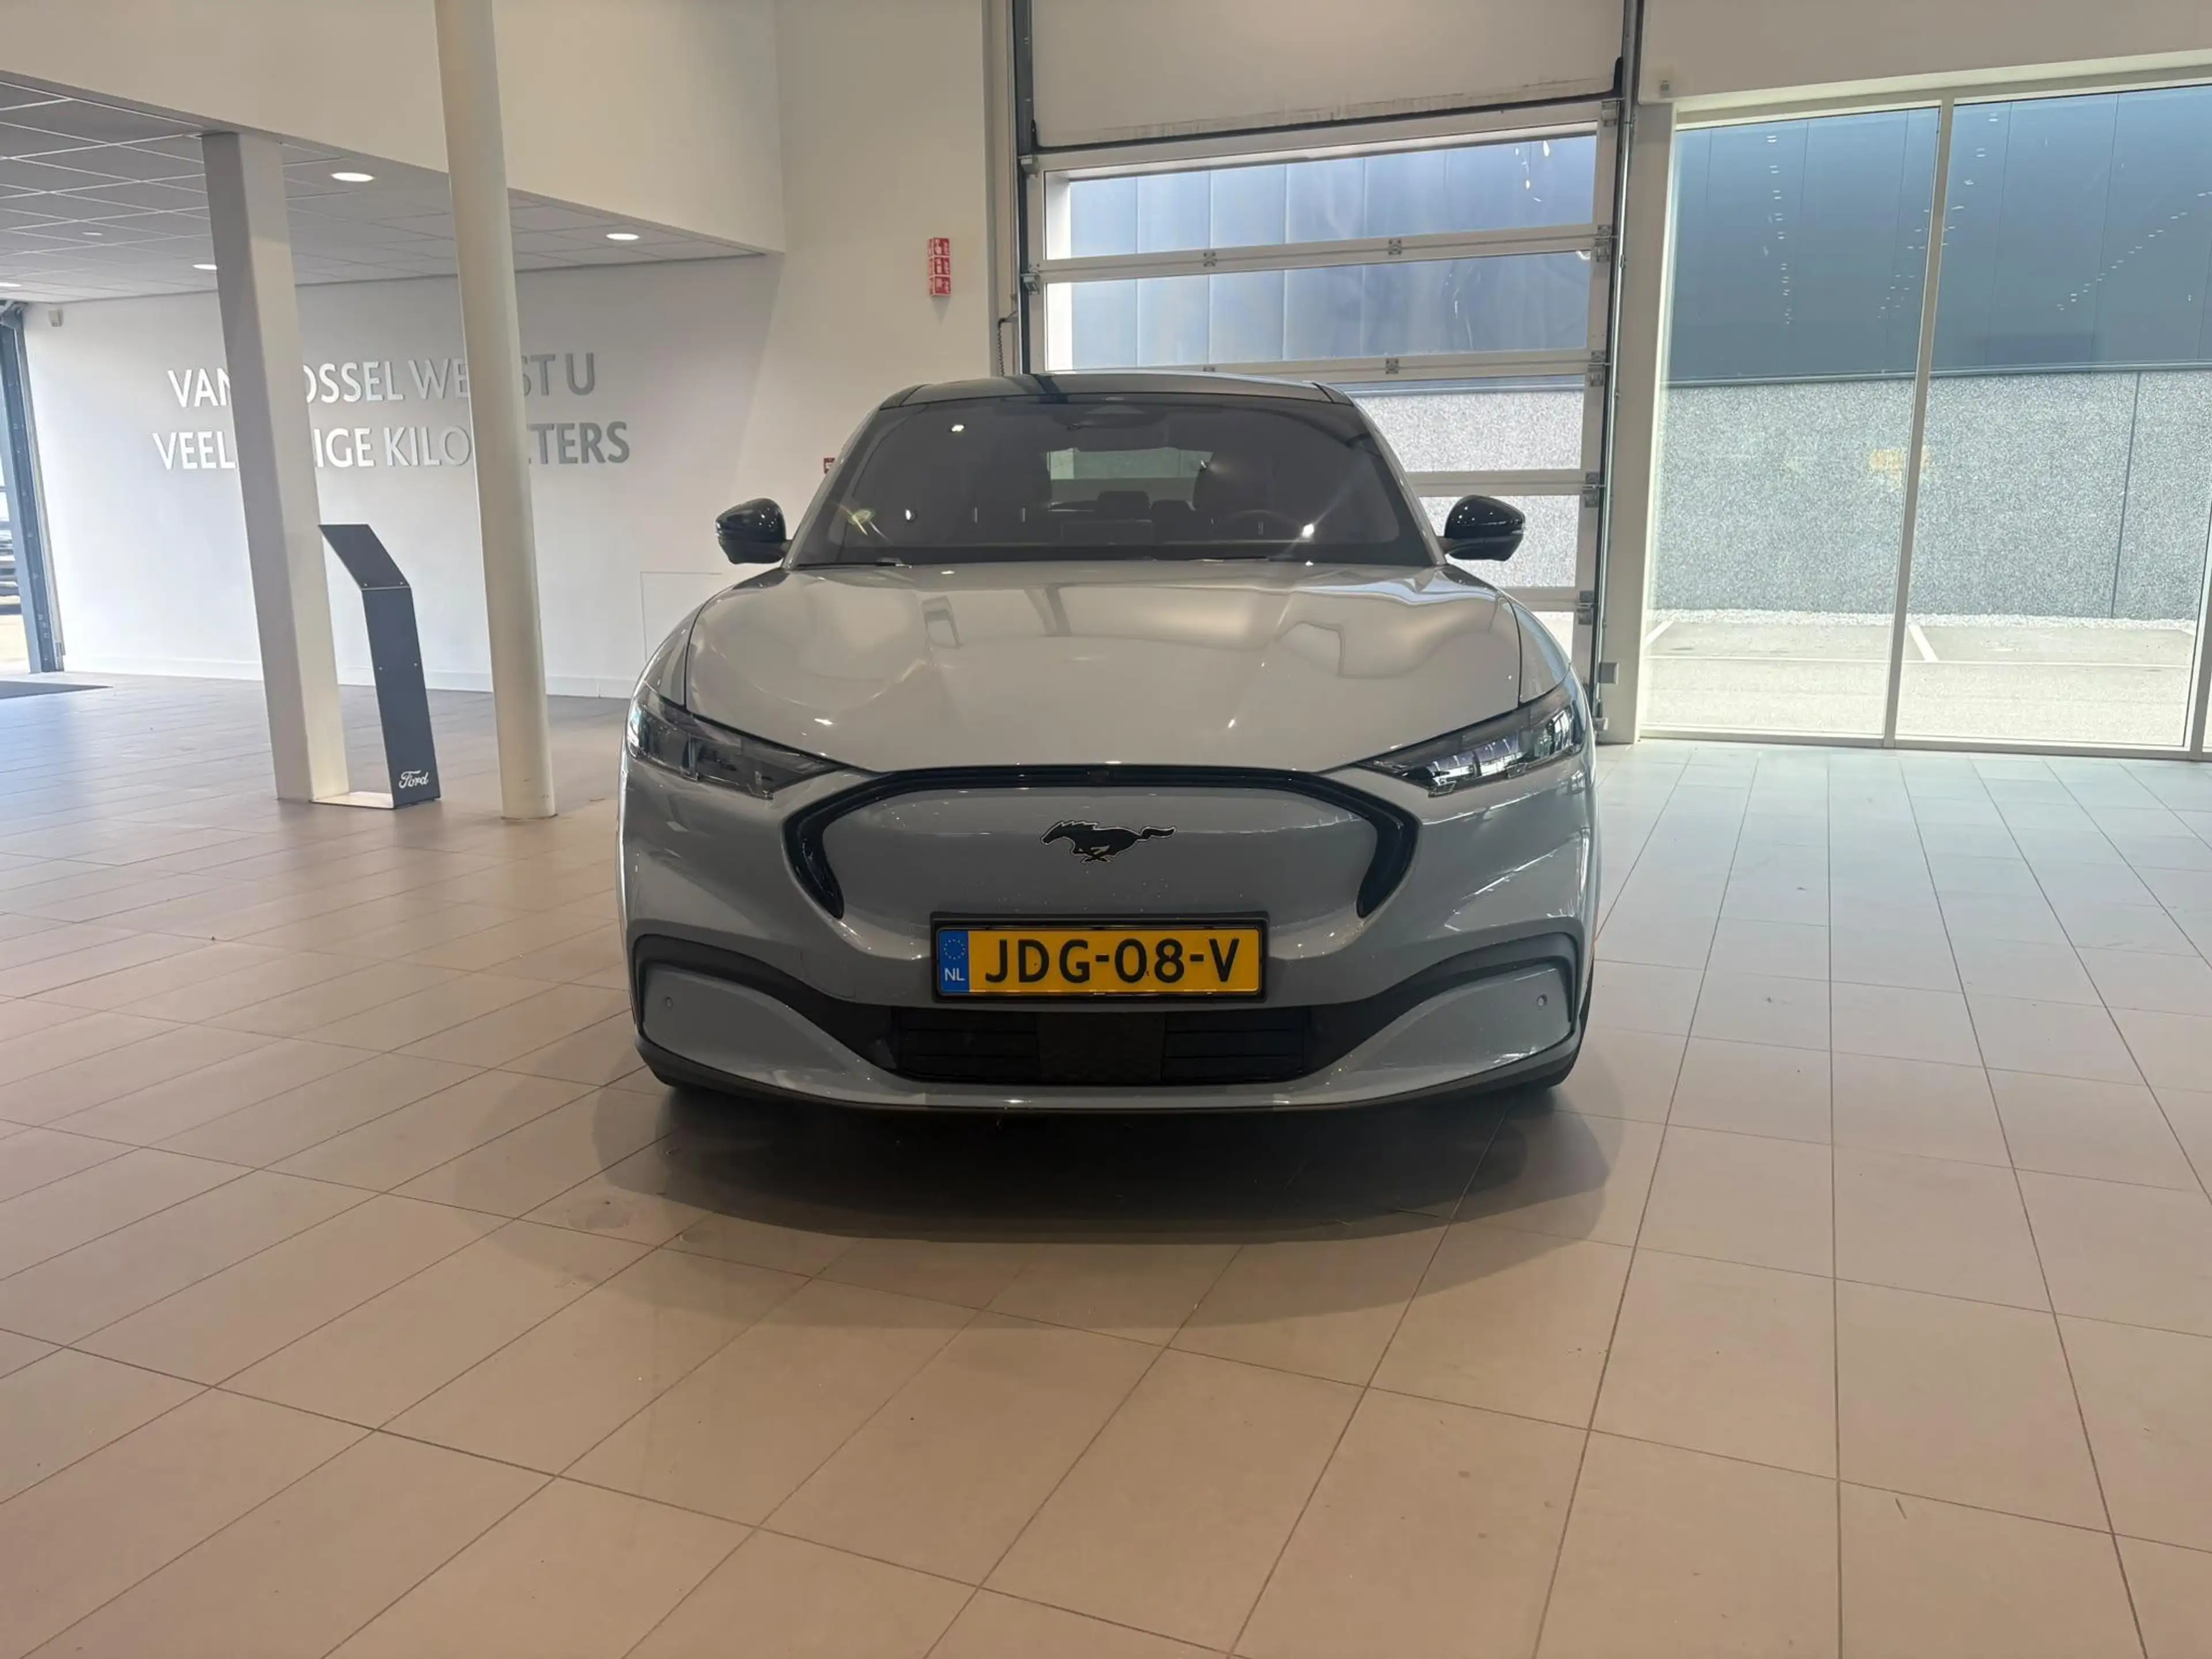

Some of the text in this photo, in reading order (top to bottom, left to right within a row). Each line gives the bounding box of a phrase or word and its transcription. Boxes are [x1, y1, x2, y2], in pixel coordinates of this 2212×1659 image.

[565, 353, 595, 396] U
[153, 431, 236, 469] VEEL
[383, 421, 630, 467] KILOTERS
[399, 770, 429, 789] Ford
[944, 938, 1240, 983] NL JDG-08-V
